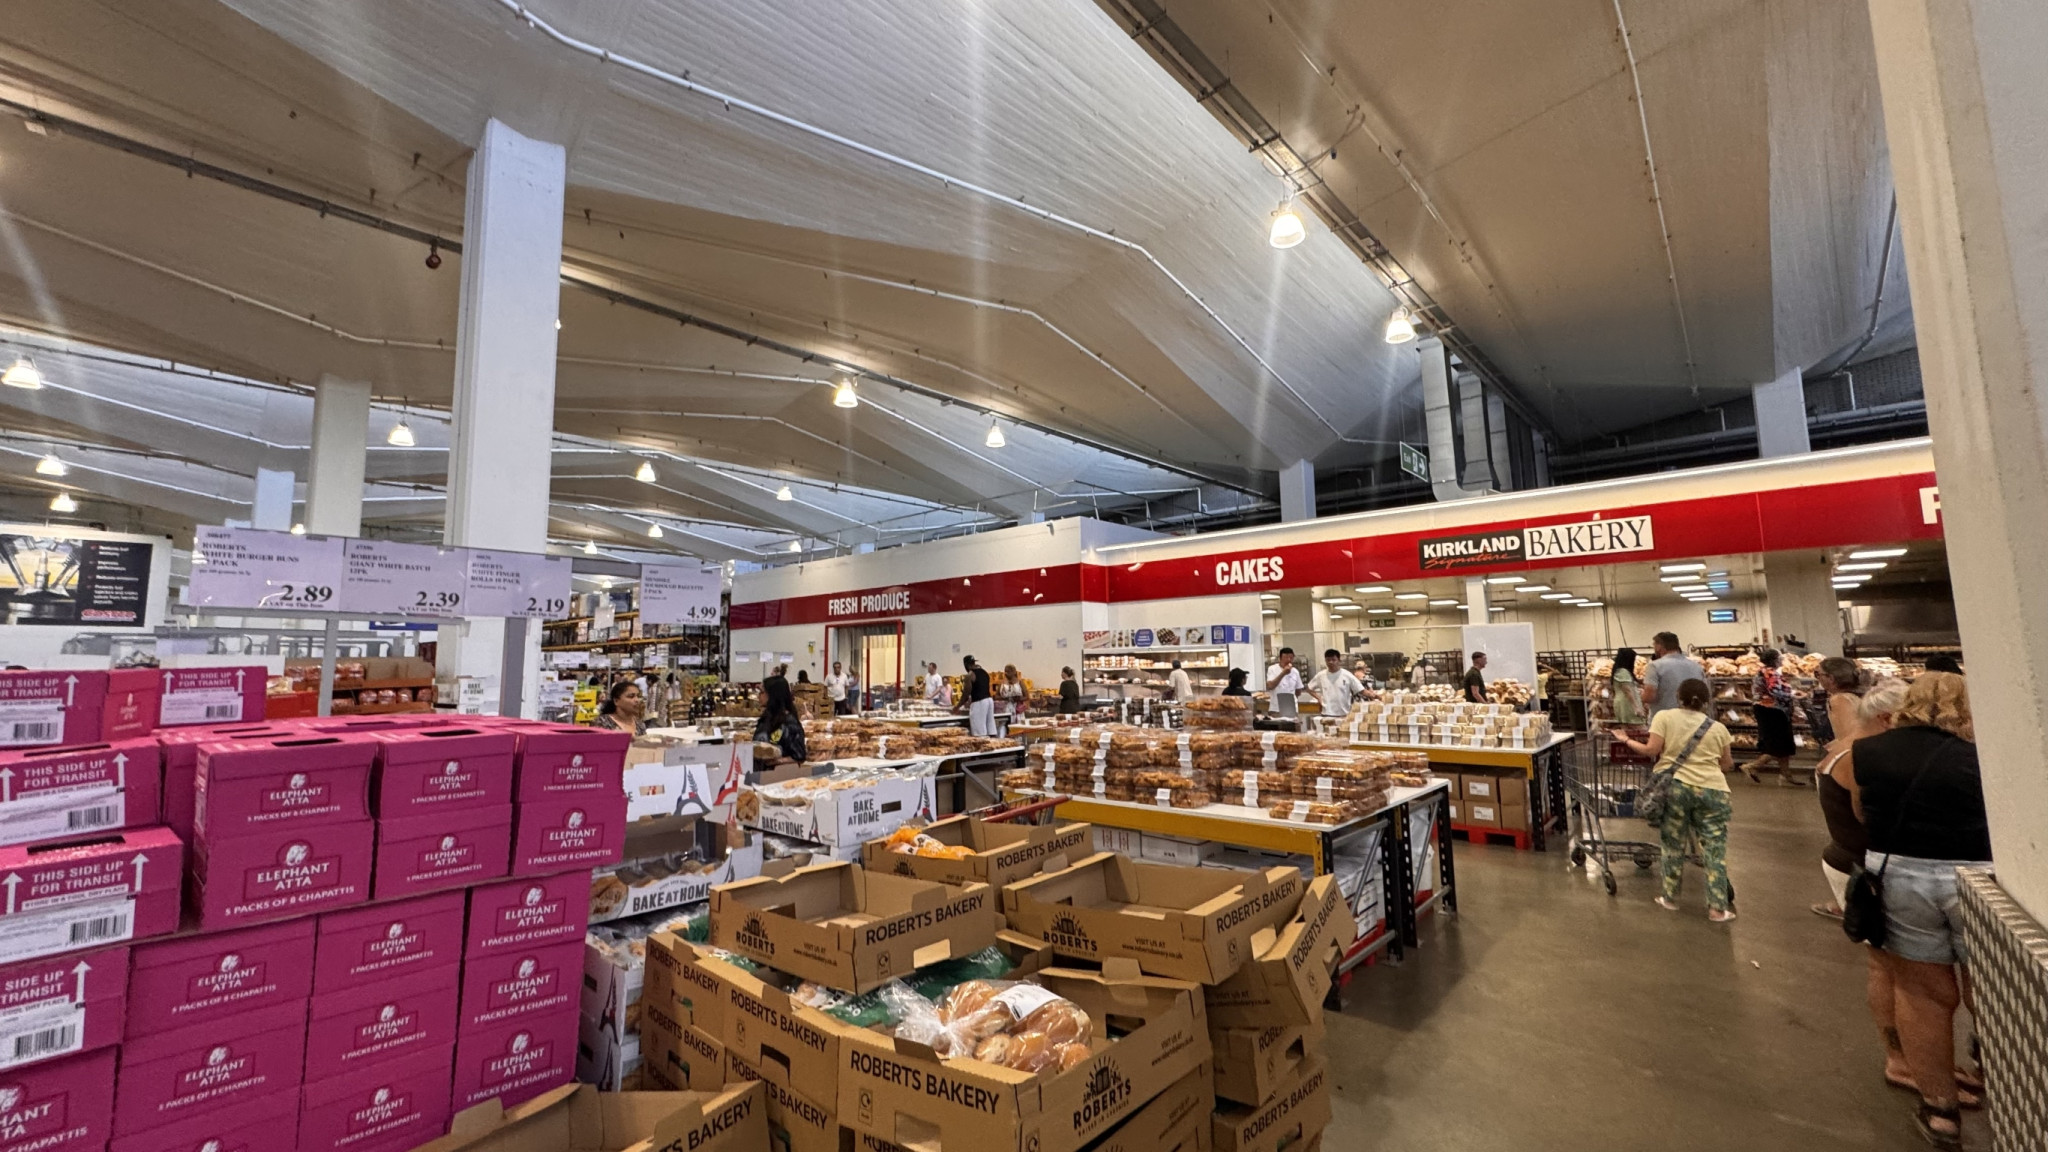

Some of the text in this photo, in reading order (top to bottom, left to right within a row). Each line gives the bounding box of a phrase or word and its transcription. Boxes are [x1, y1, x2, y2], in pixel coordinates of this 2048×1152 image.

[202, 542, 246, 551] ROBERTS
[1423, 535, 1521, 559] KIRKLAND
[1528, 518, 1647, 557] BAKERY
[201, 550, 233, 559] WHITE
[236, 552, 274, 561] BURGER
[351, 553, 388, 561] ROBERTS
[1424, 553, 1521, 569] Signature
[349, 560, 431, 572] GIANT WHITE BATCH
[496, 570, 520, 578] FINGER
[1215, 555, 1285, 586] CAKES
[280, 584, 333, 603] 2.89
[415, 591, 460, 608] 2.39
[526, 597, 565, 612] 2.19
[687, 605, 717, 619] 4.99
[828, 591, 910, 616] FRESH PRODUCE
[13, 687, 58, 697] TRANSIT
[16, 679, 39, 688] SIDE
[44, 678, 59, 687] UP
[24, 759, 107, 778] THIS SIDE UP
[558, 767, 593, 775] ELEPHANT
[24, 769, 107, 788] FOR TRANSIT
[429, 773, 471, 785] ELEPHANT
[439, 782, 461, 791] ATTA
[270, 787, 322, 800] ELEPHANT
[282, 797, 310, 806] ATTA
[853, 798, 875, 814] BAKE
[761, 816, 778, 831] BAKE
[785, 821, 804, 838] HOME
[847, 810, 880, 826] AT HOME
[549, 828, 597, 840] ELEPHANT
[560, 839, 584, 848] ATTA
[425, 848, 468, 861] ELEPHANT
[533, 856, 557, 864] PACKS
[574, 849, 611, 859] CHAPATTIS
[997, 831, 1085, 870] ROBERTS BAKERY
[33, 860, 124, 883] THIS SIDE UP
[435, 857, 457, 867] ATTA
[257, 862, 330, 883] ELEPHANT
[31, 871, 123, 896] FOR TRANSIT
[275, 876, 312, 891] ATTA
[234, 899, 270, 915] PACKS
[272, 896, 288, 907] OF
[298, 885, 354, 902] CHAPATTIS
[632, 882, 712, 912] BAKE AT HOME
[1216, 877, 1297, 934] ROBERTS BAKERY
[504, 903, 558, 920] ELEPHANT
[866, 893, 984, 946] ROBERTS BAKERY
[517, 916, 545, 927] ATTA
[1292, 886, 1338, 972] ROBERTS BAKERY
[370, 934, 418, 951] ELEPHANT
[488, 935, 514, 947] PACKS
[515, 933, 527, 942] OF
[534, 924, 575, 938] CHAPATTIS
[736, 930, 775, 955] ROBERTS
[1043, 931, 1098, 951] ROBERTS
[382, 945, 406, 956] ATTA
[197, 966, 257, 987] ELEPHANT
[649, 944, 720, 995] ROBERTS BAKERY
[5, 970, 64, 991] SIDE UP
[212, 979, 242, 993] ATTA
[497, 974, 551, 994] ELEPHANT
[0, 982, 64, 1005] TRANSIT
[179, 1001, 208, 1012] PACKS
[209, 996, 222, 1005] OF
[230, 984, 277, 1000] CHAPATTIS
[510, 987, 537, 1001] ATTA
[480, 1010, 506, 1023] PACKS
[508, 1006, 519, 1016] OF
[526, 995, 568, 1011] CHAPATTIS
[362, 1016, 410, 1036] ELEPHANT
[731, 989, 827, 1053] ROBERTS BAKERY
[373, 1027, 399, 1040] ATTA
[648, 1004, 719, 1064] ROBERTS BAKERY
[490, 1047, 544, 1071] ELEPHANT
[185, 1058, 246, 1082] ELEPHANT
[199, 1072, 231, 1087] ATTA
[503, 1062, 531, 1078] ATTA
[850, 1050, 1000, 1115] ROBERTS BAKERY
[355, 1097, 404, 1121] ELEPHANT
[779, 1092, 828, 1130] BAKERY
[1073, 1077, 1131, 1130] ROBERTS
[1243, 1101, 1289, 1145] ROBERTS
[1290, 1070, 1324, 1108] BAKERY
[367, 1110, 392, 1125] ATTA
[687, 1096, 752, 1151] BAKERY
